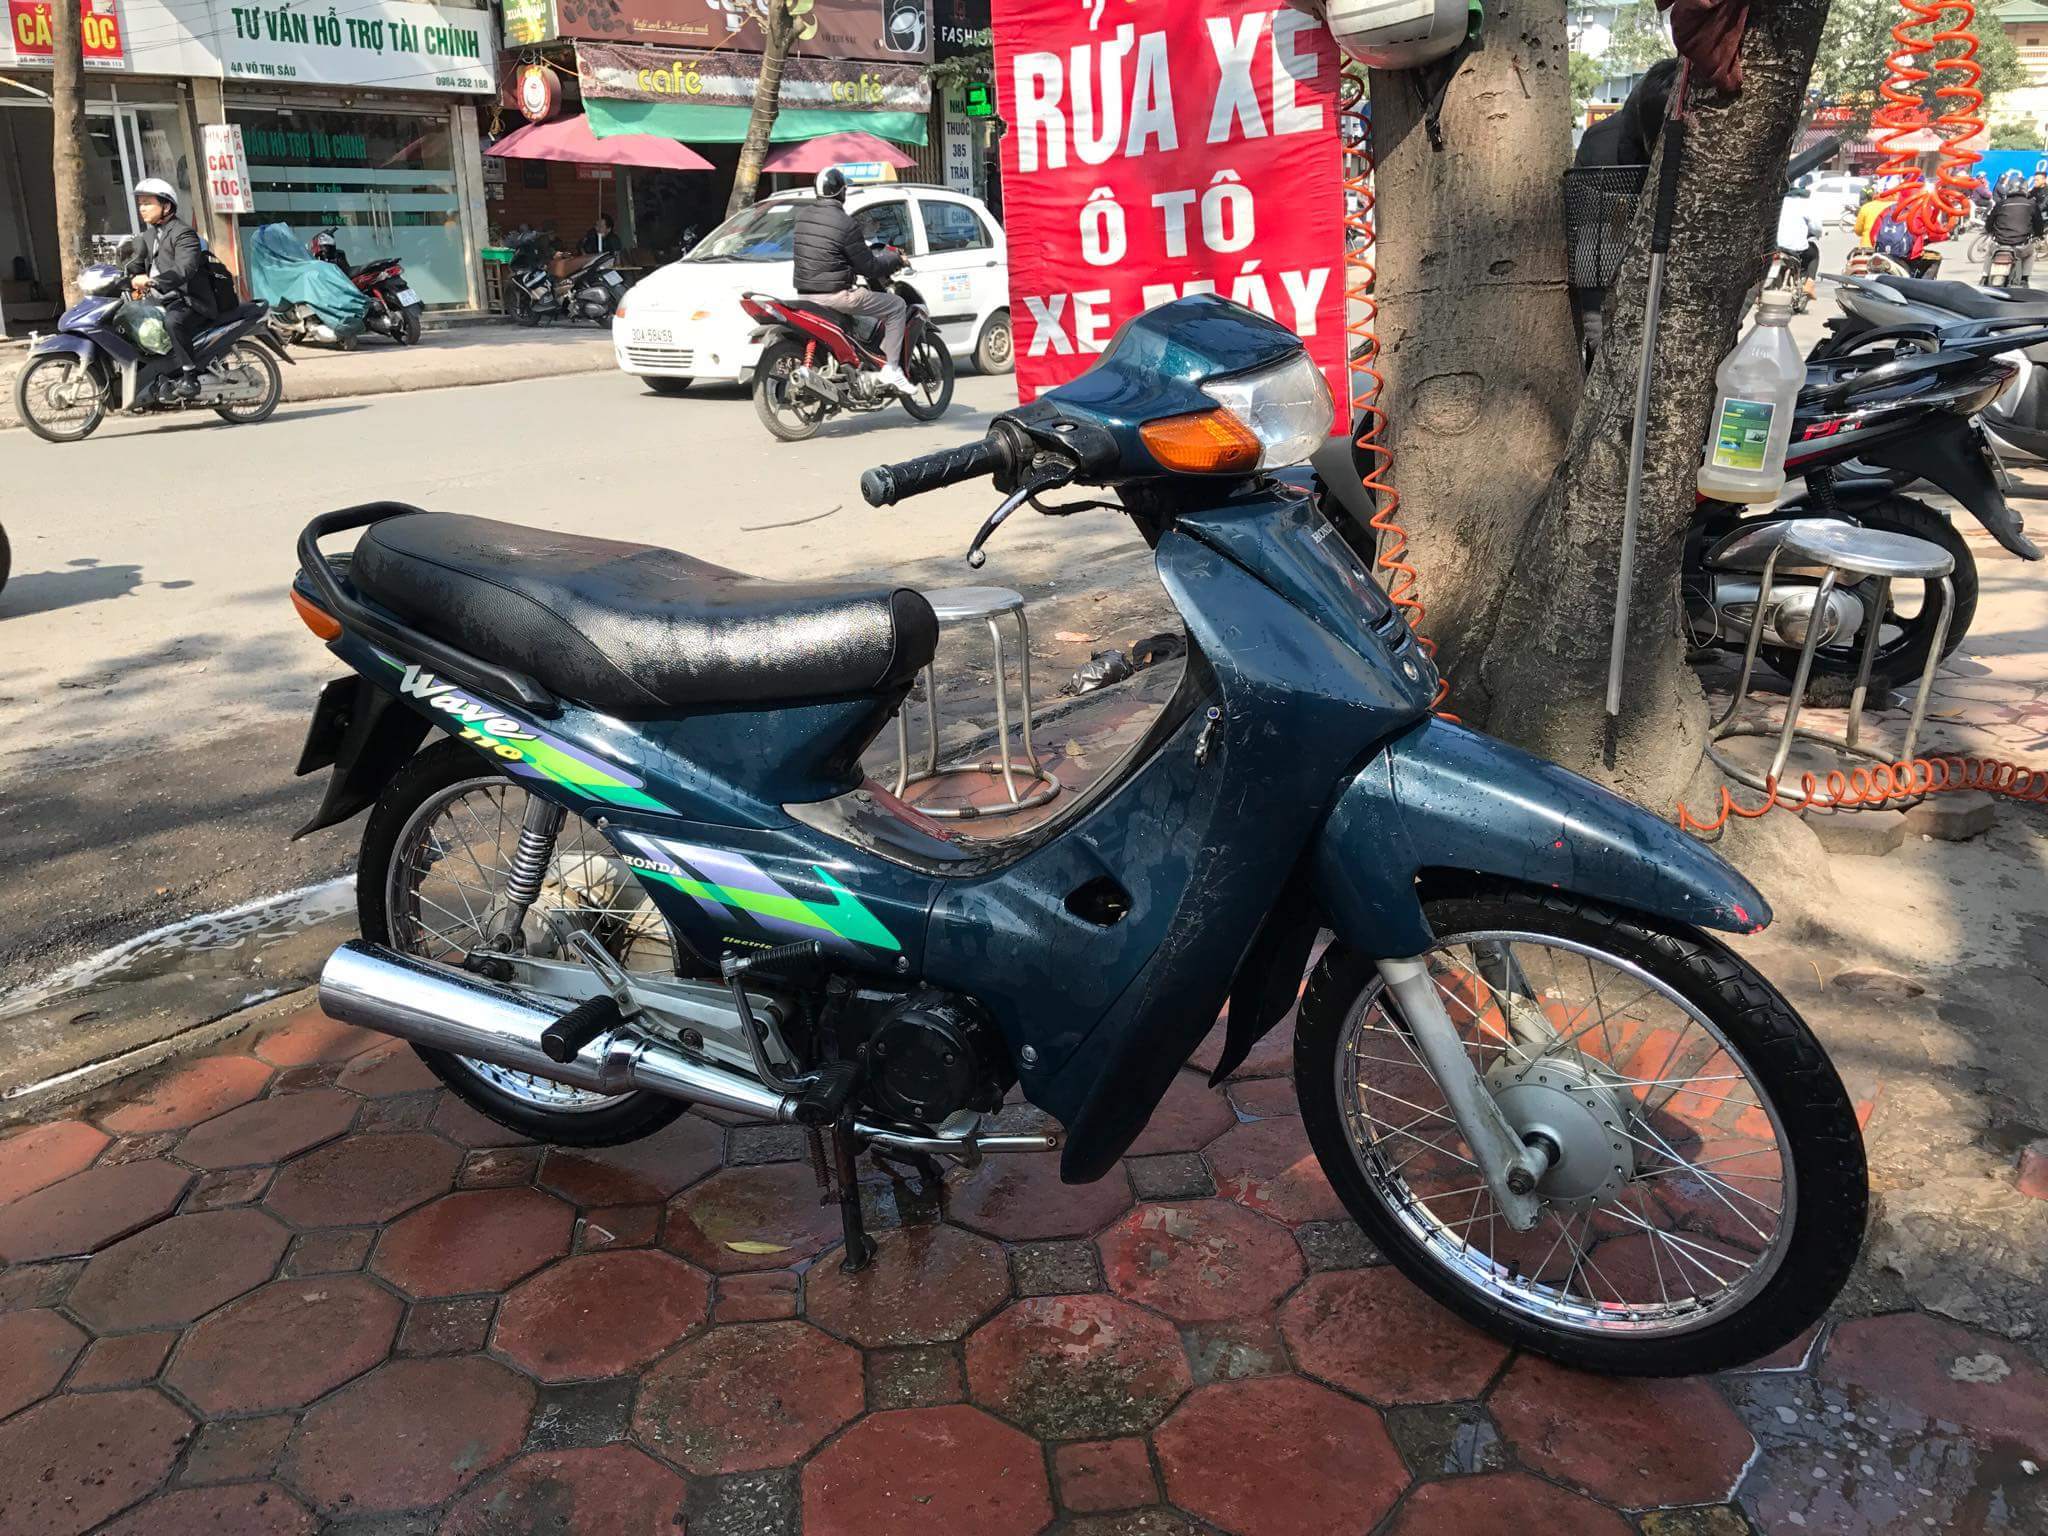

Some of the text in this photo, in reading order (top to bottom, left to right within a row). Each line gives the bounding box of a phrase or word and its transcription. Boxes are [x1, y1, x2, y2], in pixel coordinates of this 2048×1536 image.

[17, 4, 117, 49] CẮ ÓC
[231, 7, 260, 40] TƯ
[264, 3, 309, 44] VẤN
[313, 7, 342, 47] HỖ
[346, 18, 384, 56] TRỢ
[388, 17, 419, 53] TÀI
[424, 23, 480, 58] CHÍNH
[231, 62, 243, 73] 4A
[457, 78, 472, 88] 252
[638, 61, 703, 95] café
[831, 73, 884, 103] café
[1013, 0, 1324, 173] RỬA XE
[952, 143, 967, 158] 385
[1079, 169, 1255, 267] Ô TÔ
[1022, 289, 1111, 357] XE
[400, 665, 539, 741] Wave
[459, 726, 523, 760] 110
[622, 855, 682, 876] HONDA
[721, 935, 773, 951] Electric
